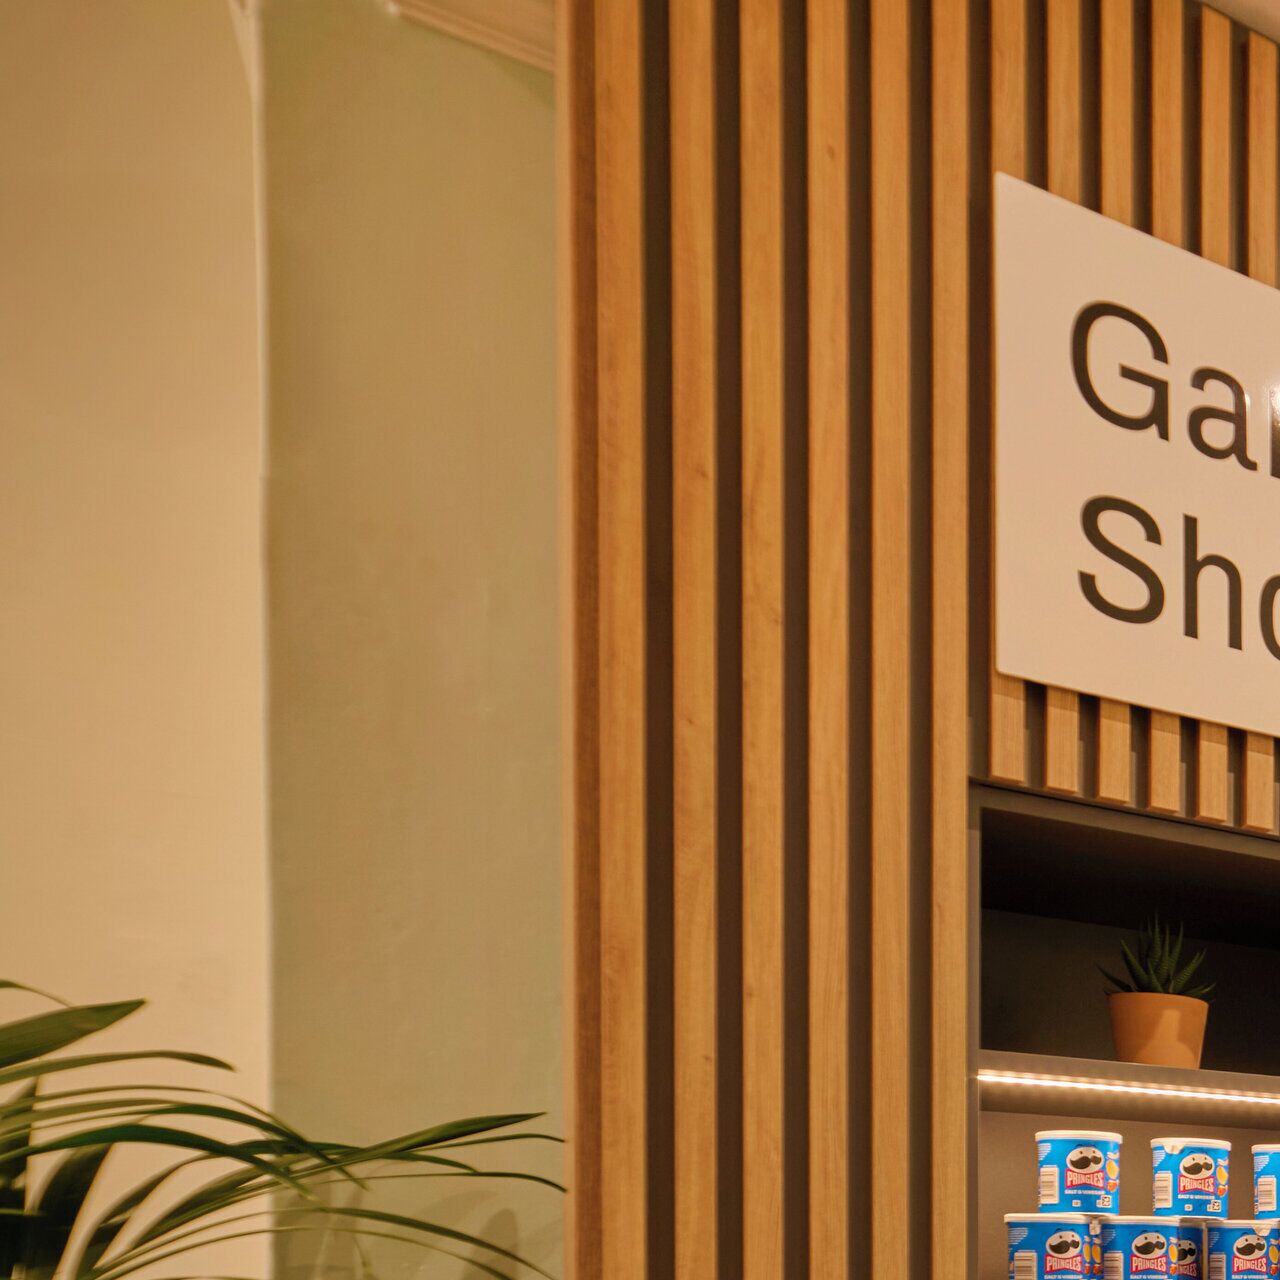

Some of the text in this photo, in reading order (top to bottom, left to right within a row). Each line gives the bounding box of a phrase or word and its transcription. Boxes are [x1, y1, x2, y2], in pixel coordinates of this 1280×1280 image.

[1065, 1170, 1104, 1188] PRINGLES
[1179, 1176, 1215, 1193] PRINGLES
[1046, 1256, 1082, 1272] PRINGLES
[1132, 1256, 1167, 1272] PRINGLES
[1233, 1257, 1267, 1273] PRINGLES
